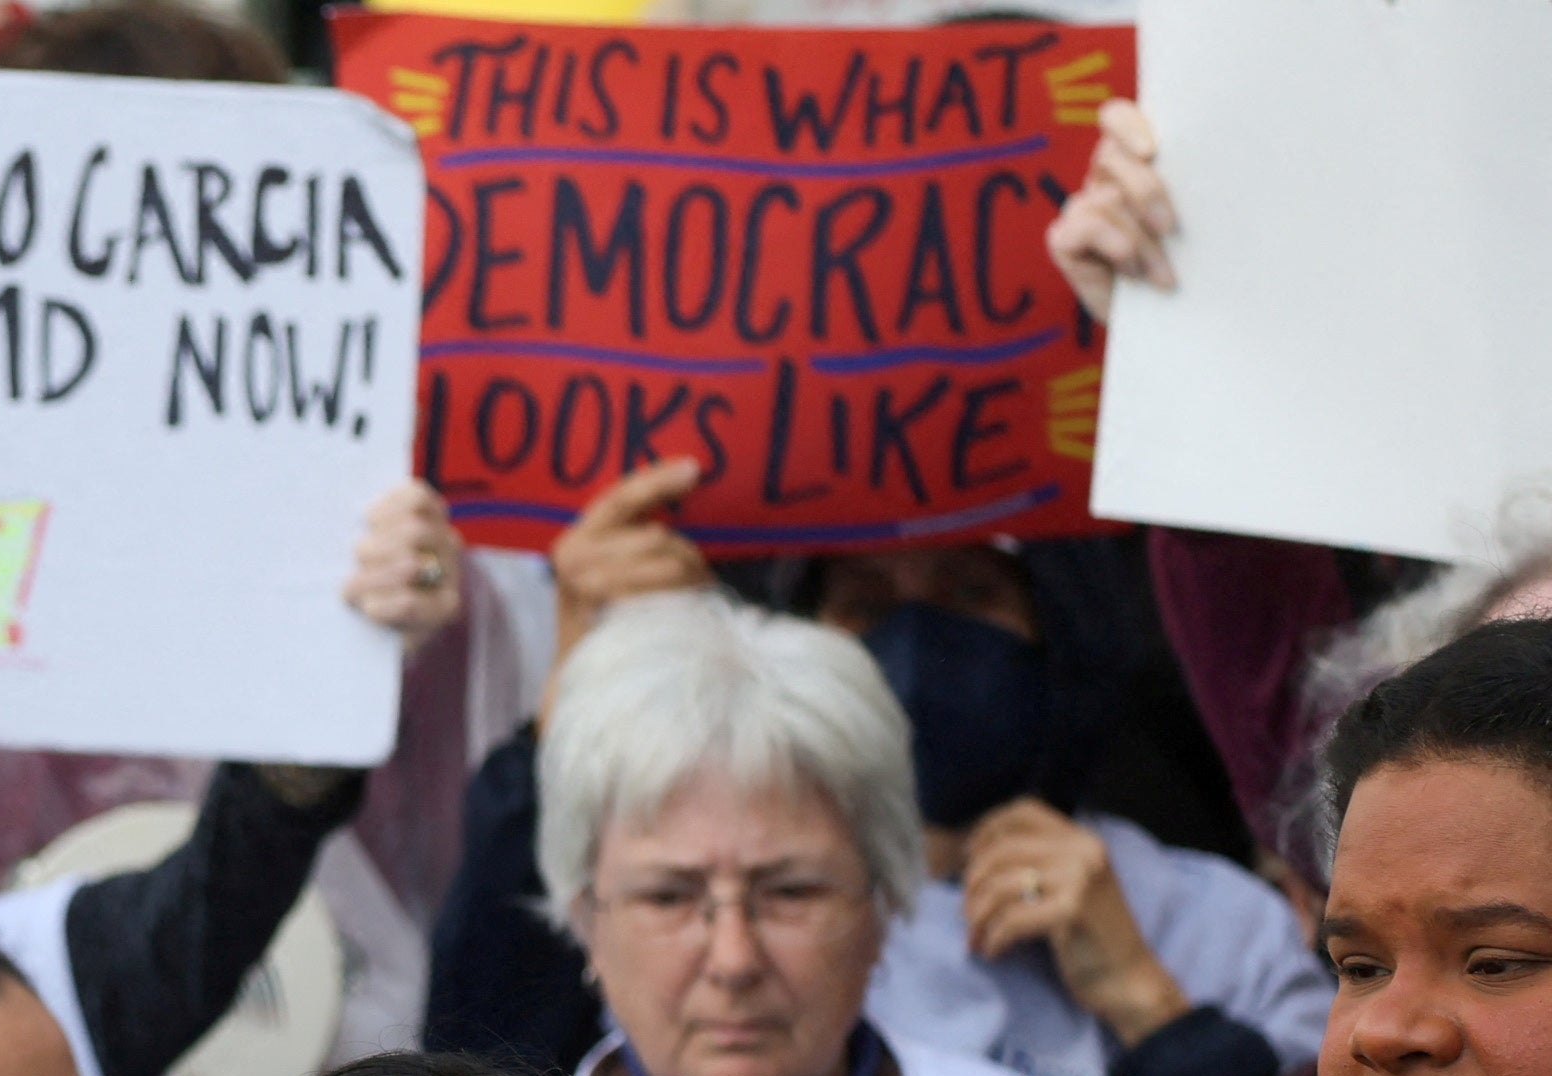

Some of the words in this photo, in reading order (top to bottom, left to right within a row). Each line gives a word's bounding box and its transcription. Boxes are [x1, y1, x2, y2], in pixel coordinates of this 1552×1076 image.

[432, 36, 639, 141] THIS
[661, 53, 739, 143] IS
[764, 31, 1060, 153] WHAT
[69, 145, 403, 285] GARCIA
[165, 312, 376, 438] NOW!
[424, 371, 735, 512] LOOKS
[762, 357, 1032, 503] LIKE
